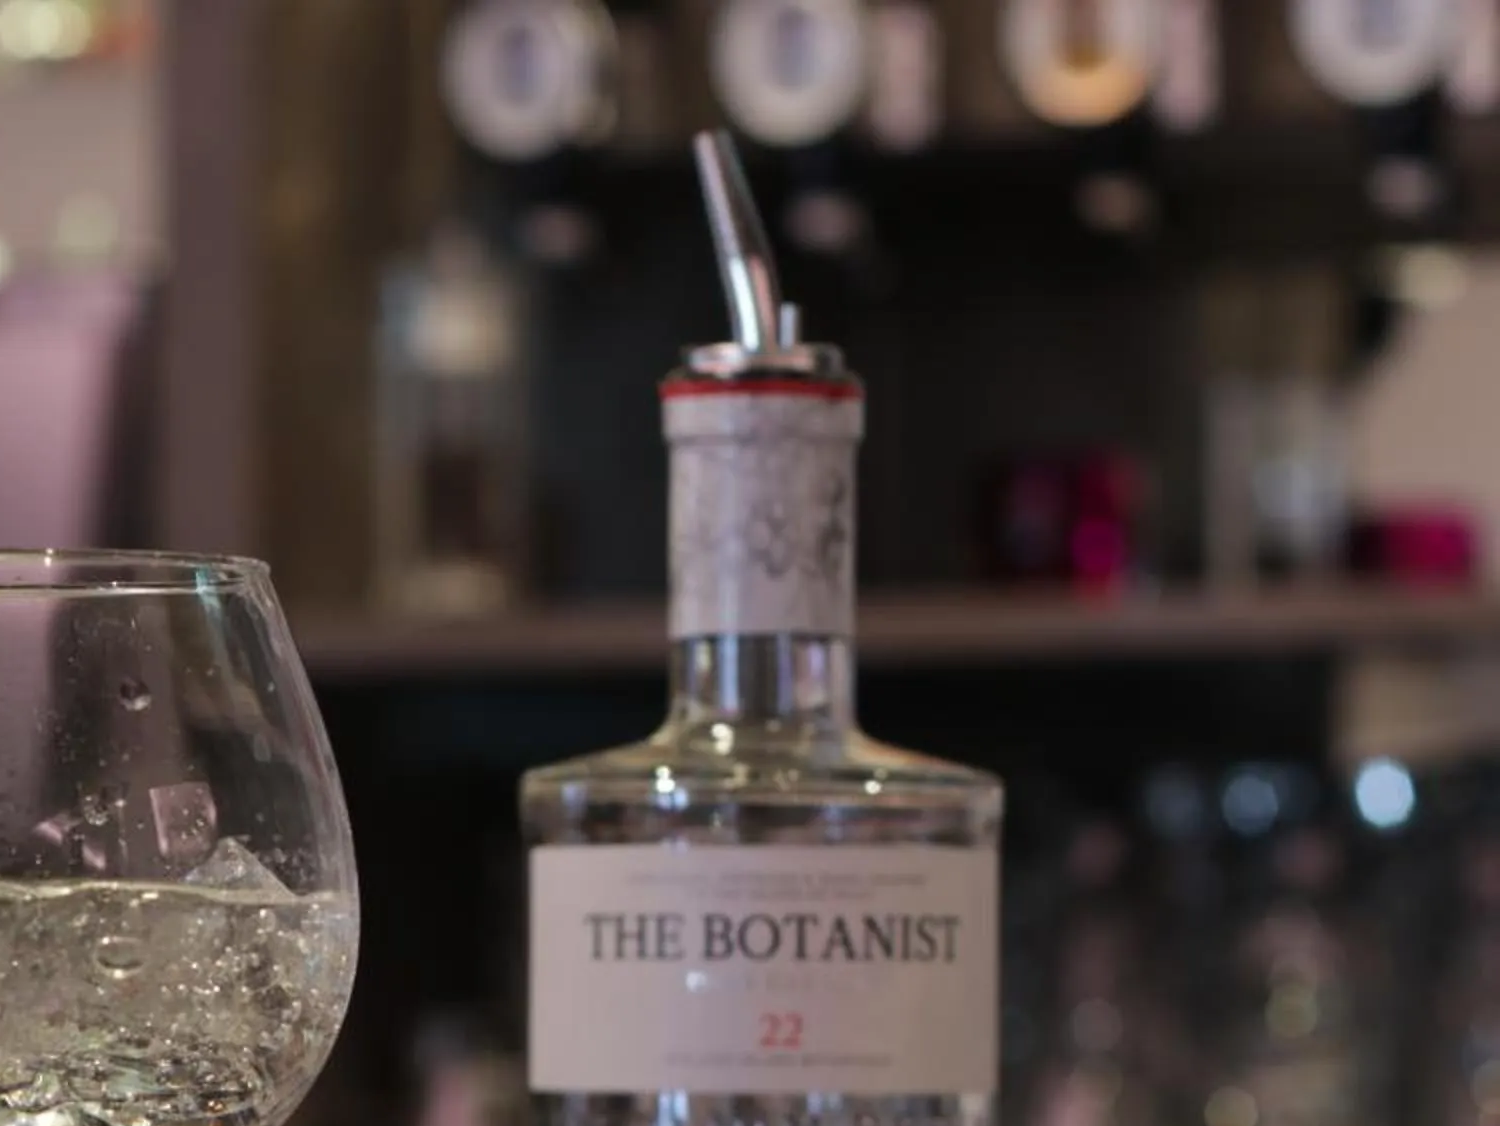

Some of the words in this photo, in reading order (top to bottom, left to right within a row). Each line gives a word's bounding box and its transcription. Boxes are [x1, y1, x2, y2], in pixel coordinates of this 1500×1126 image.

[584, 912, 687, 962] THE
[702, 911, 962, 964] BOTANIST
[758, 1013, 805, 1048] 22
